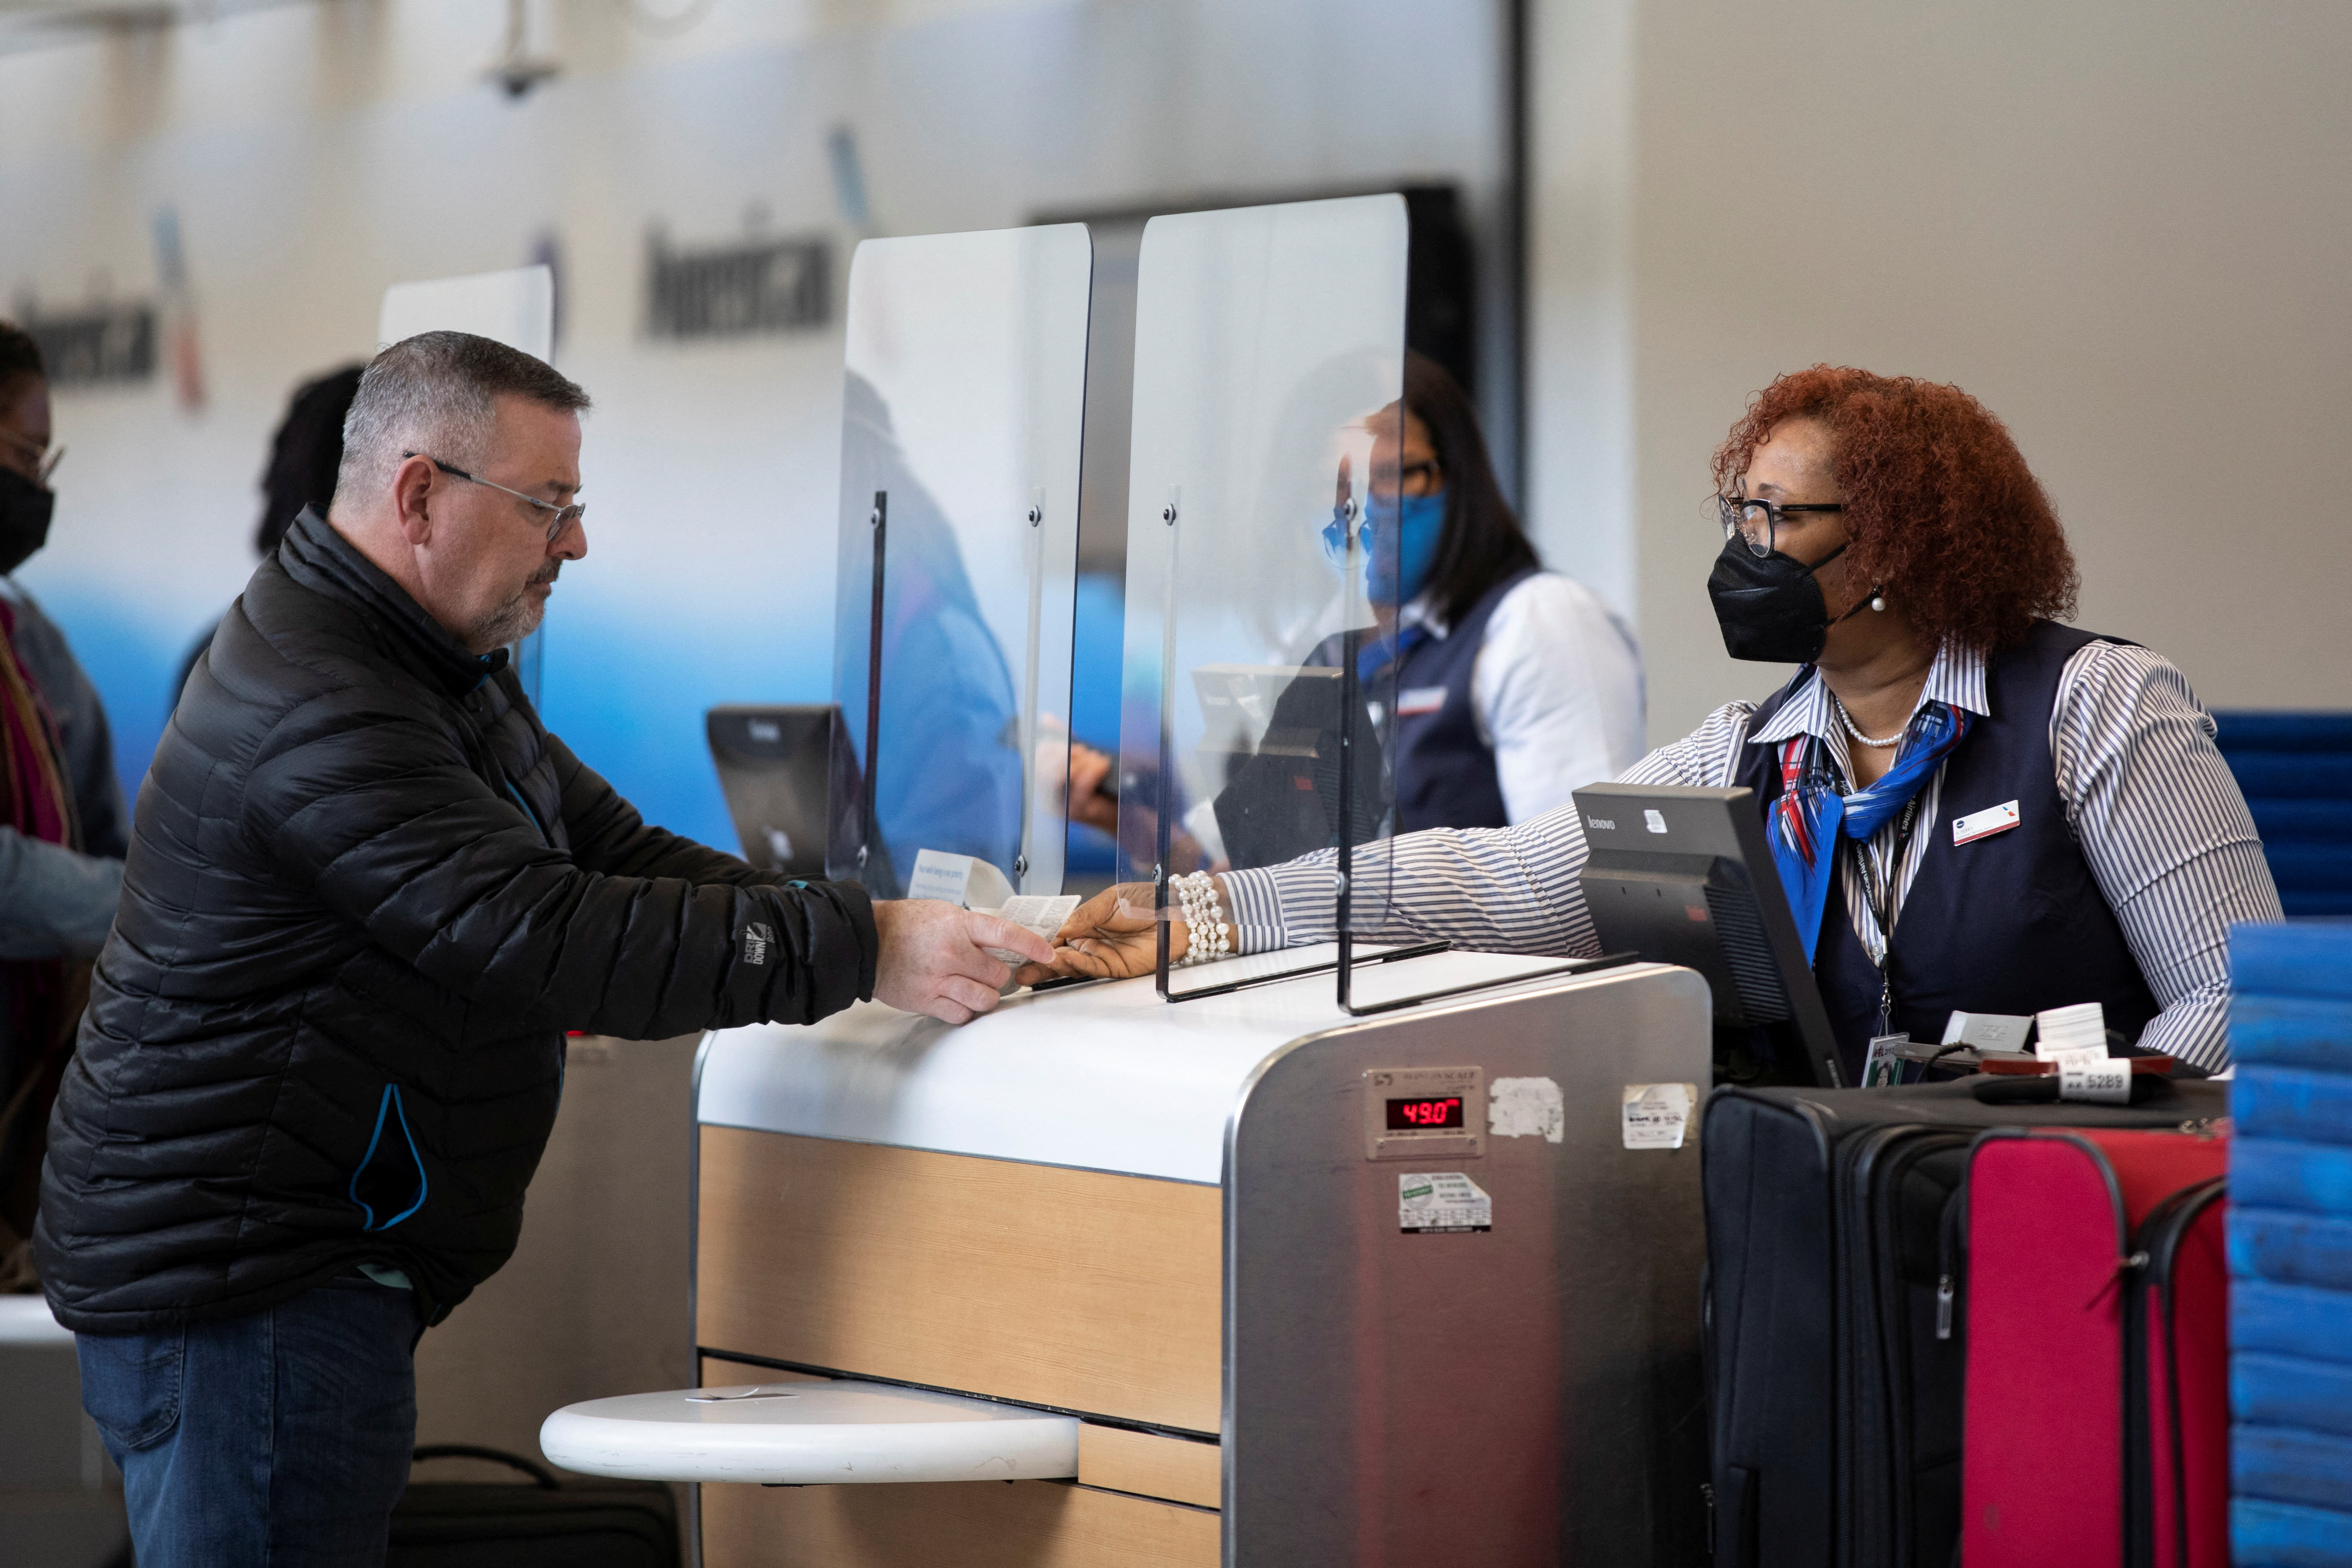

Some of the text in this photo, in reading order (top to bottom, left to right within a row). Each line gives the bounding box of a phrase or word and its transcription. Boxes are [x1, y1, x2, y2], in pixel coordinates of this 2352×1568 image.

[1587, 815, 1615, 830] lenovo
[753, 941, 766, 965] DOWN
[2088, 1075, 2124, 1089] 5289
